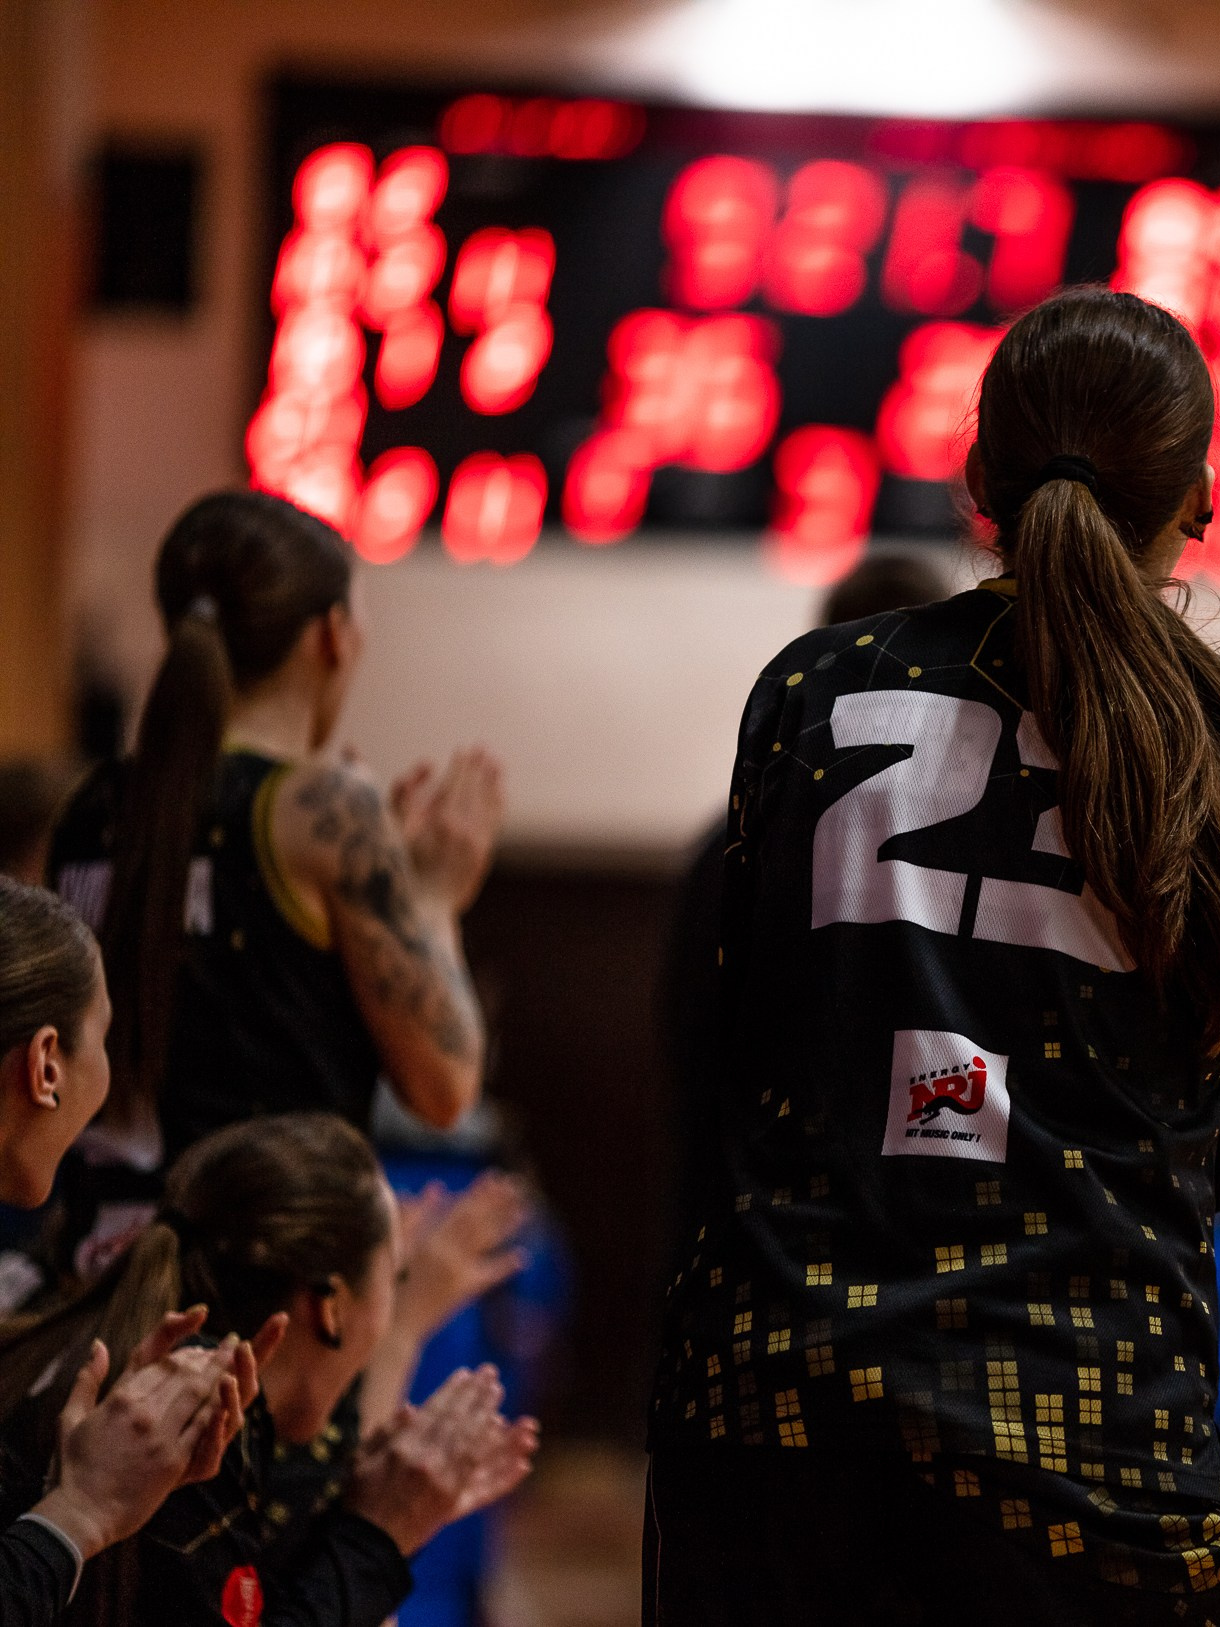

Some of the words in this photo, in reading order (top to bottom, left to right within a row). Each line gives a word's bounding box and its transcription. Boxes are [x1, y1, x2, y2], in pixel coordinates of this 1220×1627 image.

[909, 1063, 970, 1085] ENERGY
[905, 1129, 919, 1138] HIT
[920, 1129, 950, 1139] MUSIC
[951, 1131, 975, 1142] ONLY
